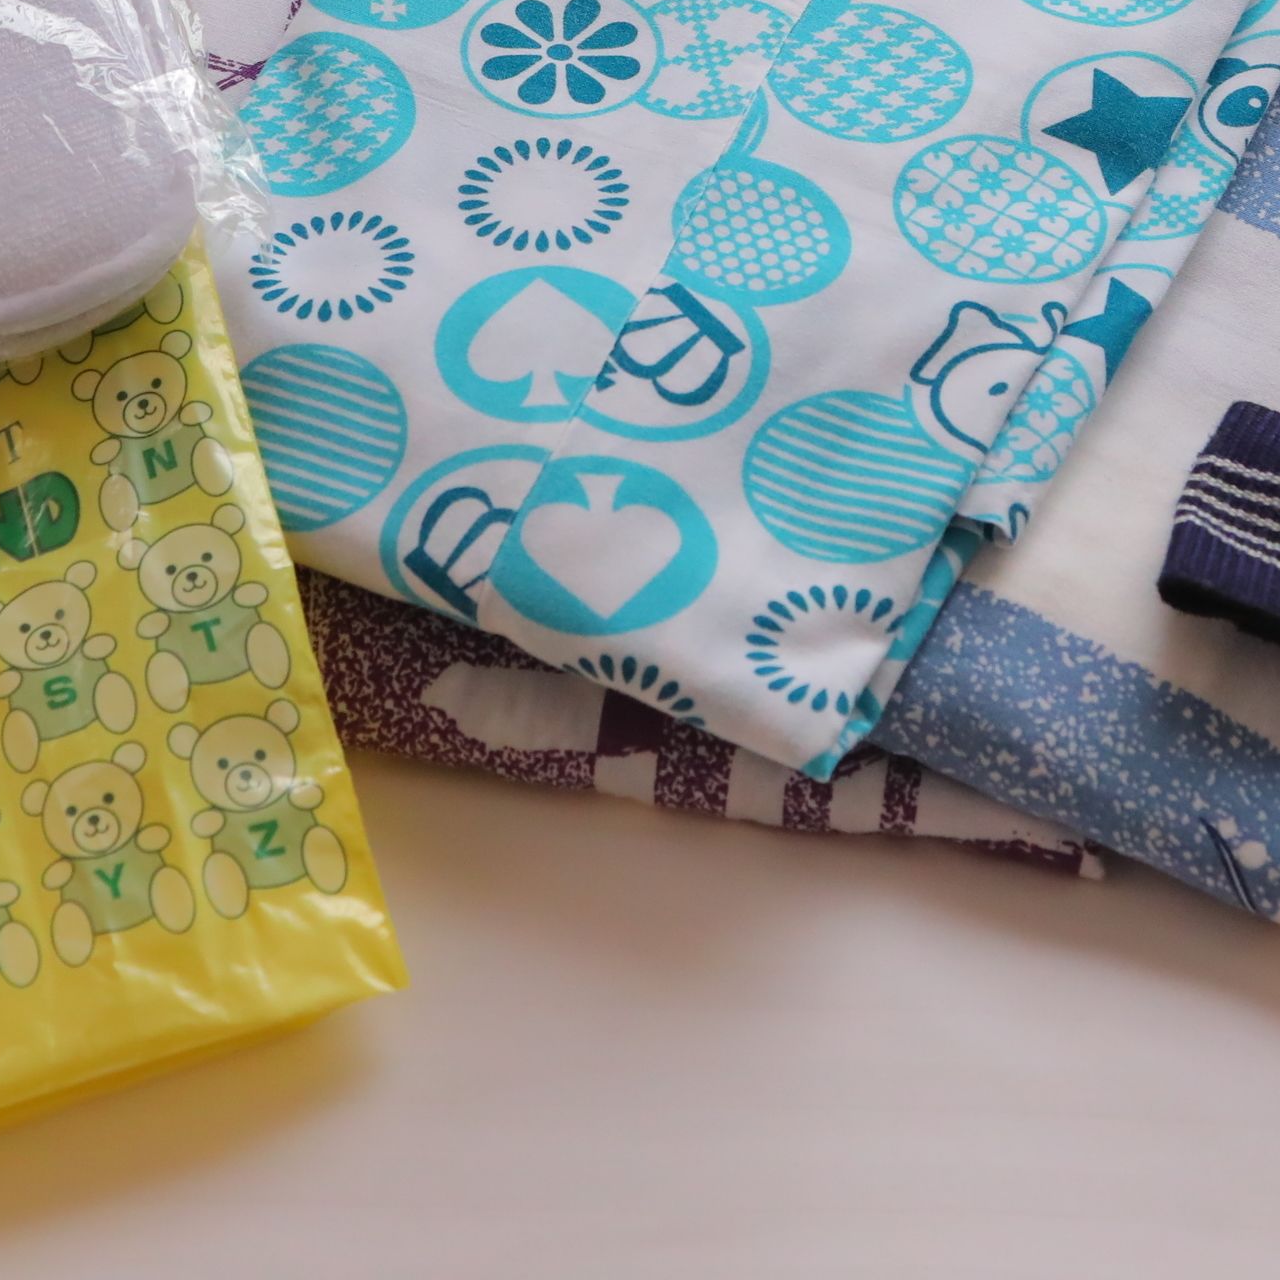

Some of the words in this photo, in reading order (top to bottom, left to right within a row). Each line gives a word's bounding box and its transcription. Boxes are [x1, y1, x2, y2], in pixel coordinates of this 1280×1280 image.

[142, 438, 178, 480] N
[190, 618, 224, 653] T
[42, 675, 78, 709] S
[247, 820, 288, 863] Z
[94, 862, 126, 900] Y
